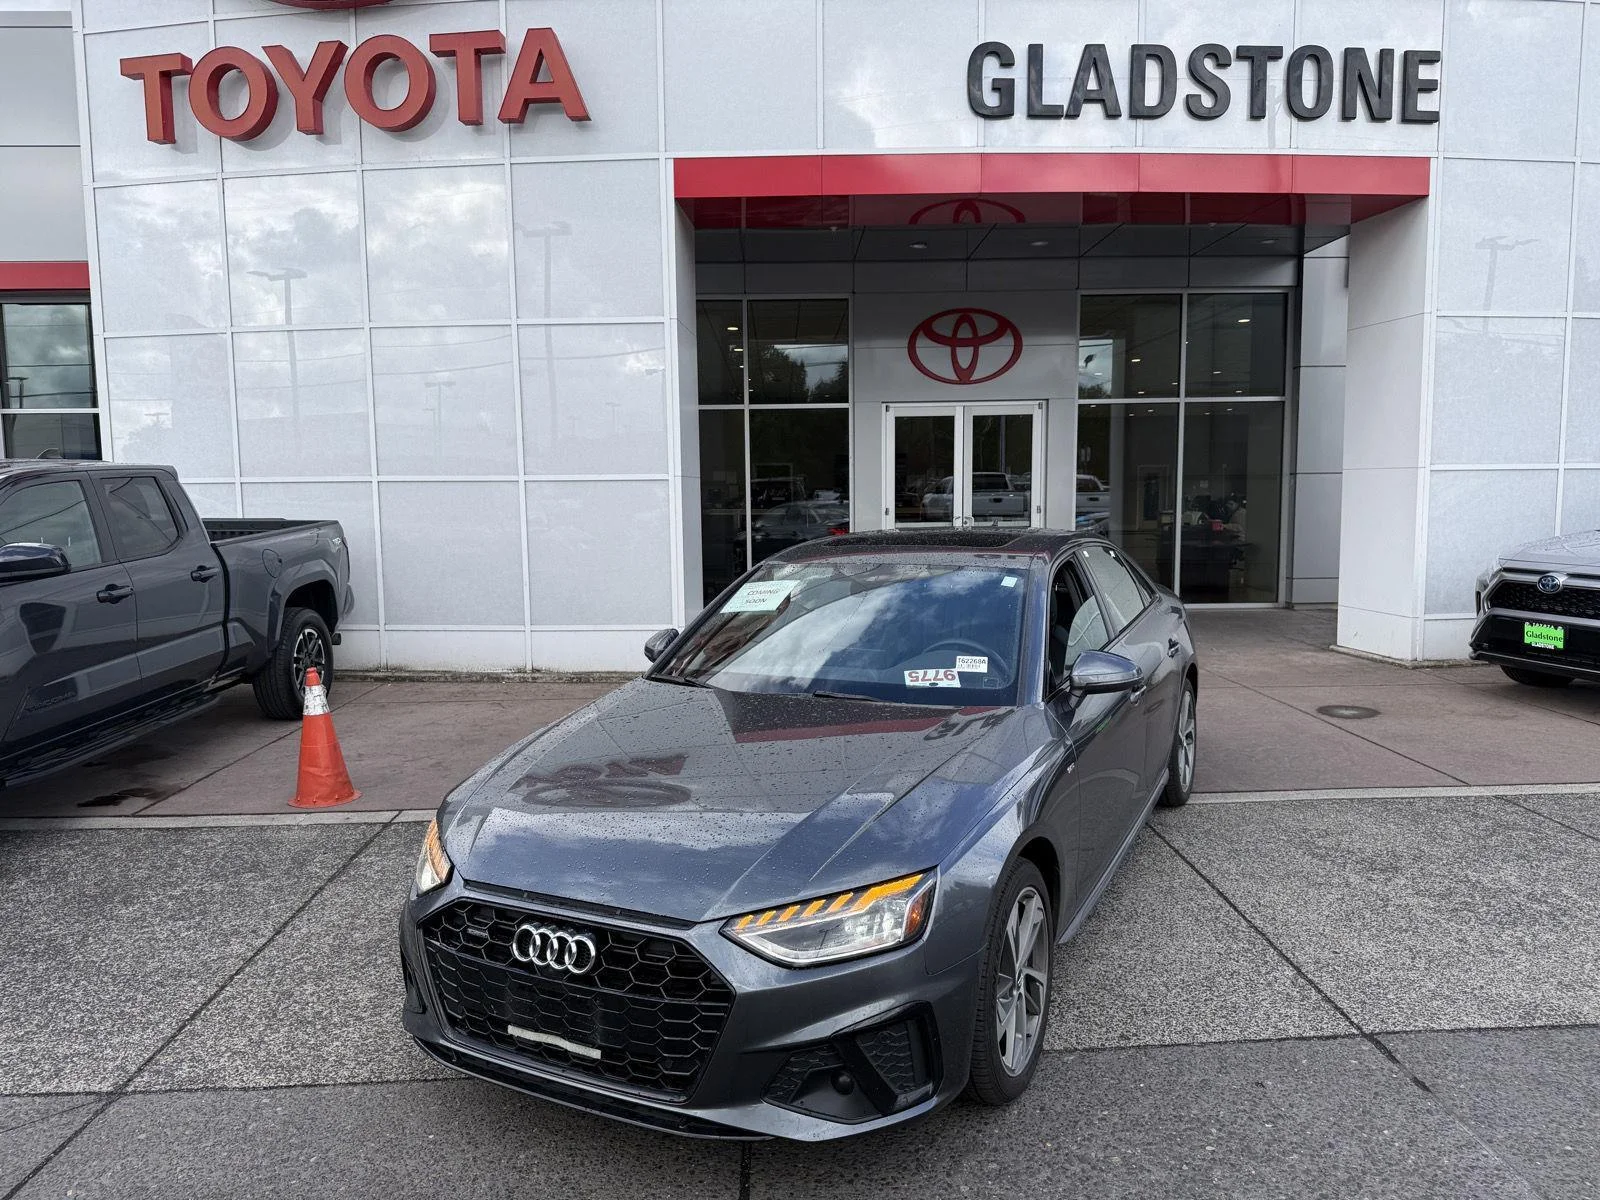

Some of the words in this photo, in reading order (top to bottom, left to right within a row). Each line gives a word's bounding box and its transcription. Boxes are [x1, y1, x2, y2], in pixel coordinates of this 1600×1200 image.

[120, 27, 591, 144] TOYOTA
[966, 41, 1441, 124] GLADSTONE
[747, 588, 780, 596] COMING
[1525, 630, 1563, 643] Gladstone
[908, 669, 957, 682] 9775
